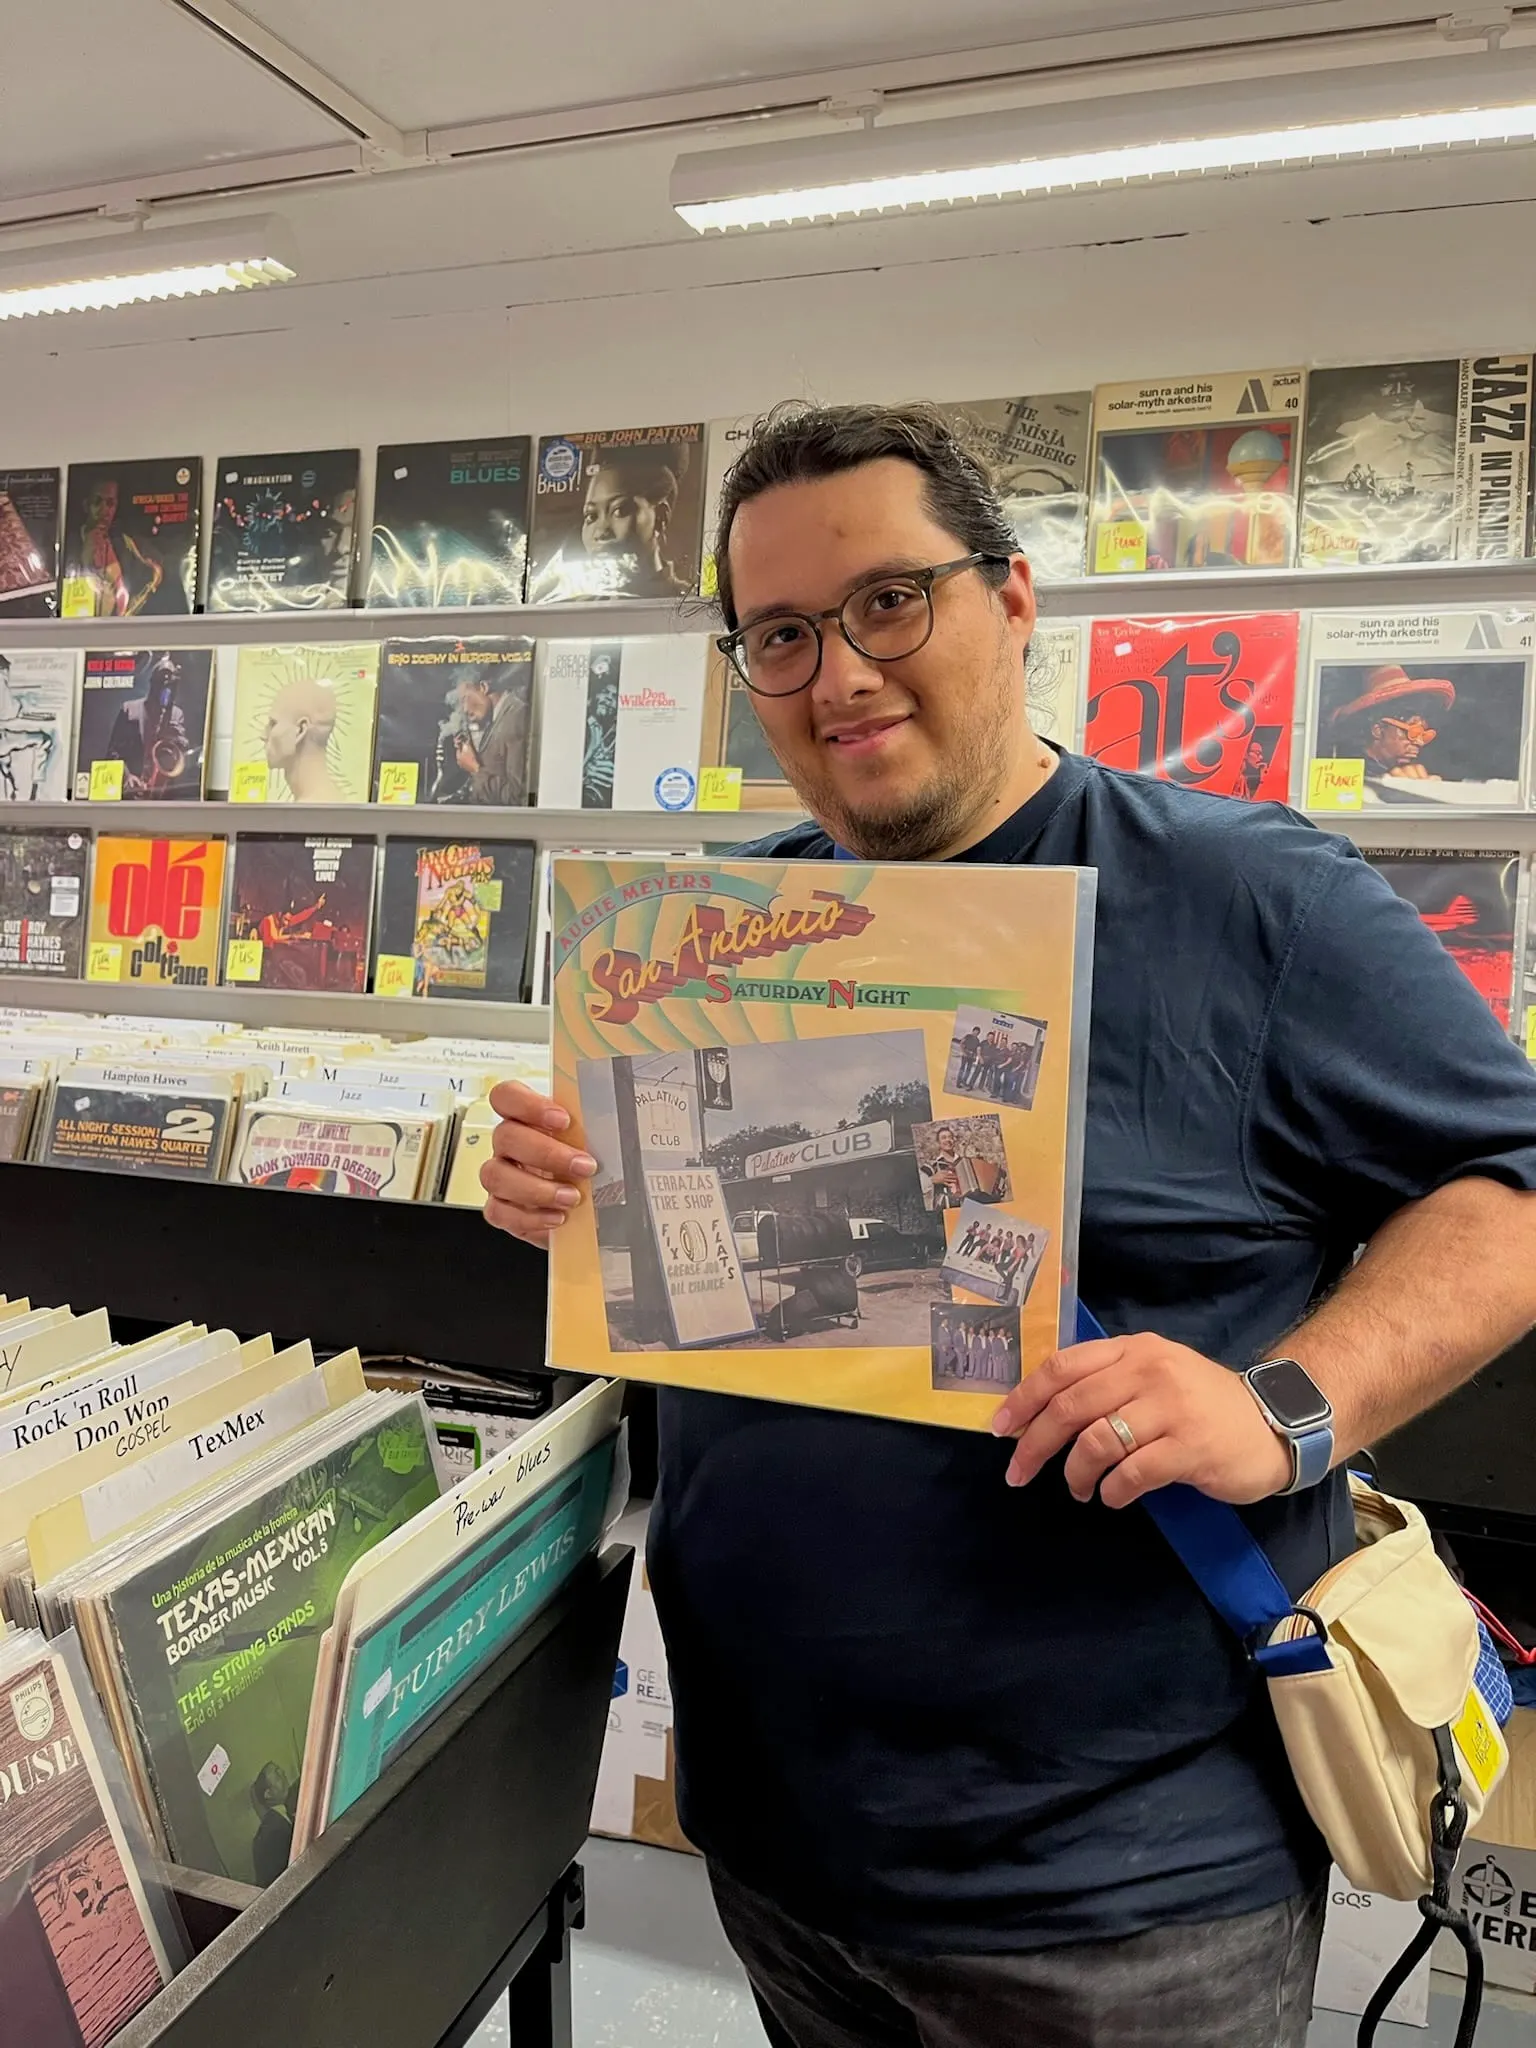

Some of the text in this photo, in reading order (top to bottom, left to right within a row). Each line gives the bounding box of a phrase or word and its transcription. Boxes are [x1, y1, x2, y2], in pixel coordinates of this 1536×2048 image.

[1461, 358, 1470, 381] HANS
[1139, 383, 1213, 398] sun ra and his
[1273, 375, 1300, 387] actuel
[1108, 393, 1212, 411] solar-myth arkestra
[1285, 398, 1298, 409] 40
[1469, 357, 1528, 443] JAZZ
[585, 431, 607, 444] BIG
[609, 429, 643, 443] JOHN
[648, 425, 700, 440] PATTON
[1458, 417, 1467, 438] HAN
[1480, 451, 1512, 471] IN
[450, 466, 521, 484] BLUES
[1360, 616, 1440, 628] sun ra and his
[1326, 628, 1439, 641] solar-myth arkestra
[1520, 636, 1532, 647] 41
[1059, 648, 1072, 664] 11
[620, 694, 676, 707] Wilkerson
[642, 688, 665, 700] Don
[1325, 773, 1360, 789] FRANCE
[108, 839, 208, 939] olé
[559, 874, 712, 951] AUGIE MEYERS
[130, 936, 208, 986] coltrane
[239, 952, 254, 964] US
[588, 900, 845, 1020] San Antonio
[704, 973, 911, 1010] SATURDAY NIGHT
[256, 1040, 281, 1051] Keith
[23, 1060, 32, 1073] E
[102, 1070, 188, 1086] Hampton Hawes
[322, 1068, 464, 1092] M Jazz M
[281, 1081, 429, 1107] L Jazz L
[634, 1090, 688, 1112] PALATINO
[56, 1119, 160, 1138] ALL NIGHT SESSION!
[161, 1109, 216, 1143] 2
[66, 1132, 210, 1155] HAMPTON HAWES QUARTET
[650, 1133, 681, 1146] CLUB
[752, 1132, 872, 1177] Palatino CLUB
[249, 1153, 382, 1186] LOOK TOWARD A DREAM
[648, 1174, 715, 1192] TERRAZAS
[651, 1194, 714, 1211] TIRE SHOP
[711, 1219, 735, 1280] FLATS
[13, 1408, 69, 1450] Rock
[74, 1400, 92, 1419] 'n
[98, 1374, 139, 1411] Roll
[74, 1420, 120, 1452] Doo
[116, 1413, 172, 1457] GOSPEL
[188, 1408, 266, 1461] TexMex
[454, 1442, 552, 1537] Pre-war blues
[152, 1507, 298, 1609] Una historia de la musica de la frontera
[157, 1502, 336, 1641] TEXAS-MEXICAN
[166, 1575, 277, 1666] BORDER MUSIC
[387, 1600, 495, 1720] FURRY
[496, 1525, 577, 1617] LEWIS
[177, 1599, 315, 1715] THE STRING BANDS
[15, 1680, 42, 1702] PHILIPS
[184, 1664, 265, 1735] End of a Tradition
[1332, 1891, 1372, 1909] GQS
